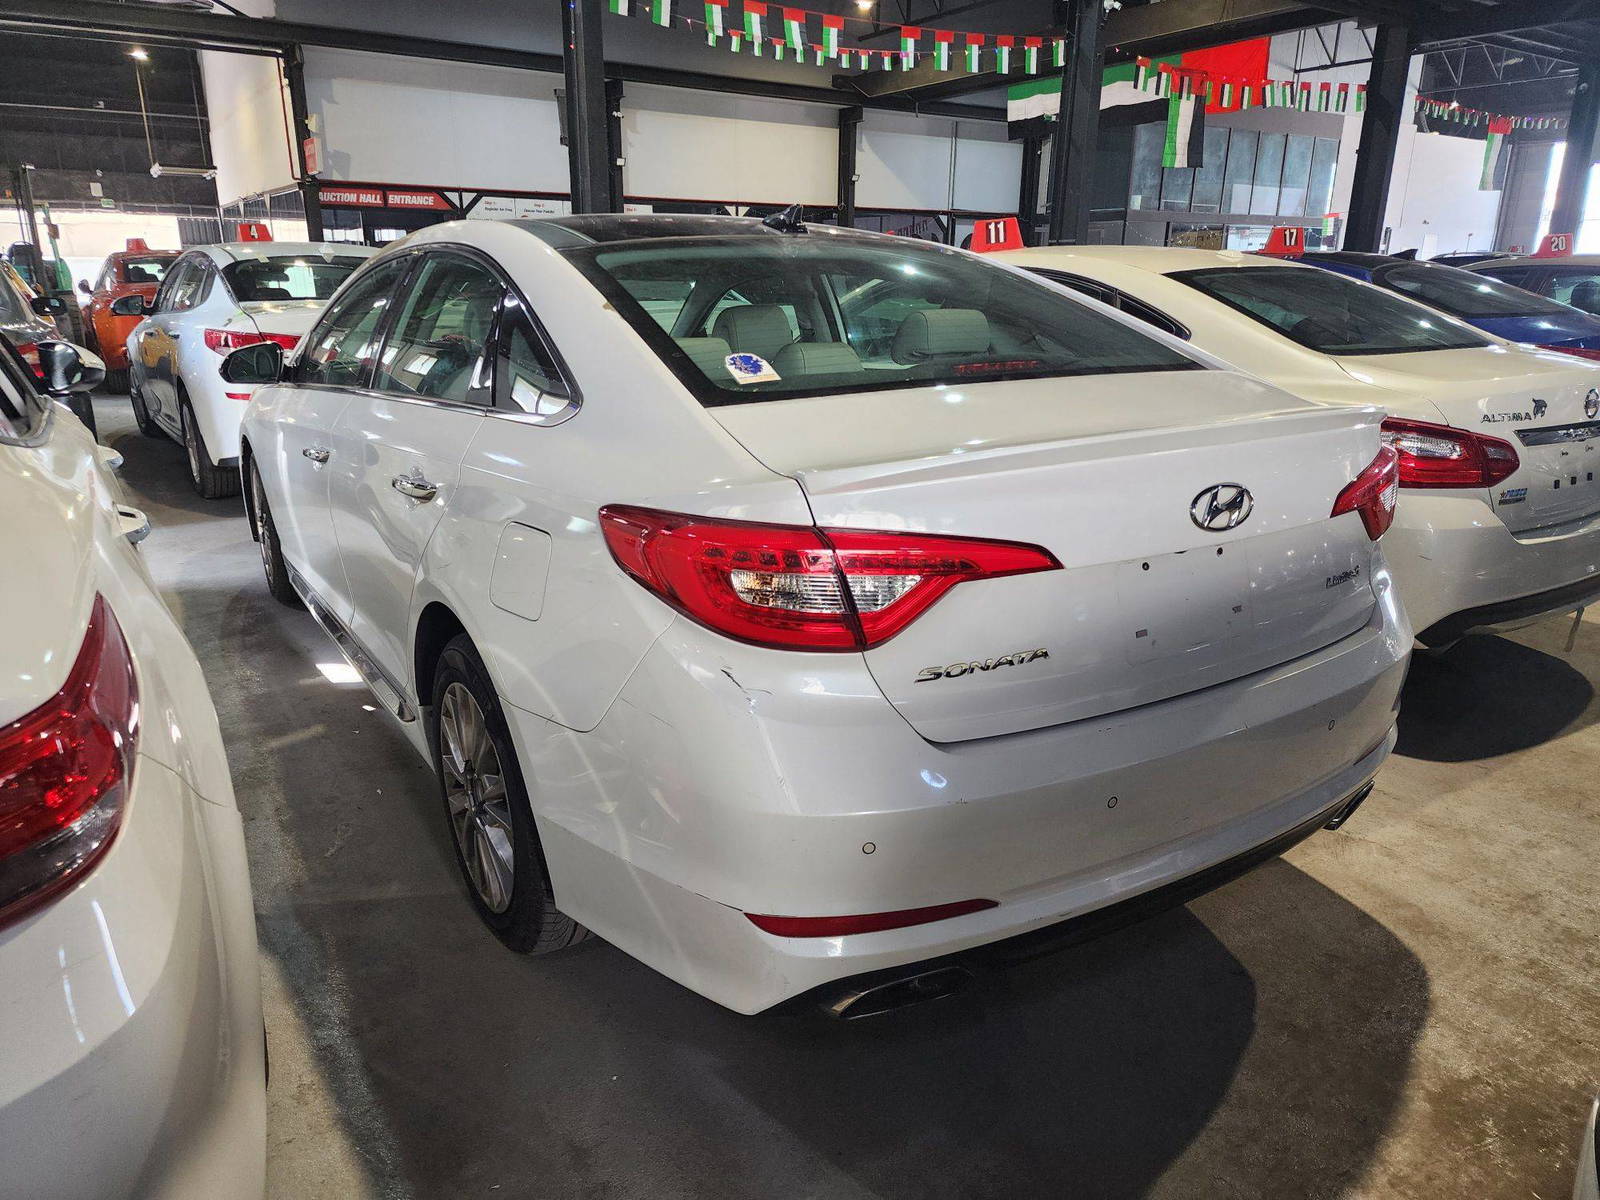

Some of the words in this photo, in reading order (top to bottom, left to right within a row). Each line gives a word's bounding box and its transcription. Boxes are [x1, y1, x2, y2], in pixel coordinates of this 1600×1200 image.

[319, 191, 357, 203] AUCTION
[359, 193, 382, 204] HALL
[388, 194, 434, 206] ENTRANCE
[250, 224, 259, 239] 4
[988, 220, 1005, 244] 11
[1284, 228, 1297, 246] 17
[1551, 236, 1566, 252] 20
[1481, 411, 1532, 423] ALTIMA
[914, 648, 1049, 683] SONATA
